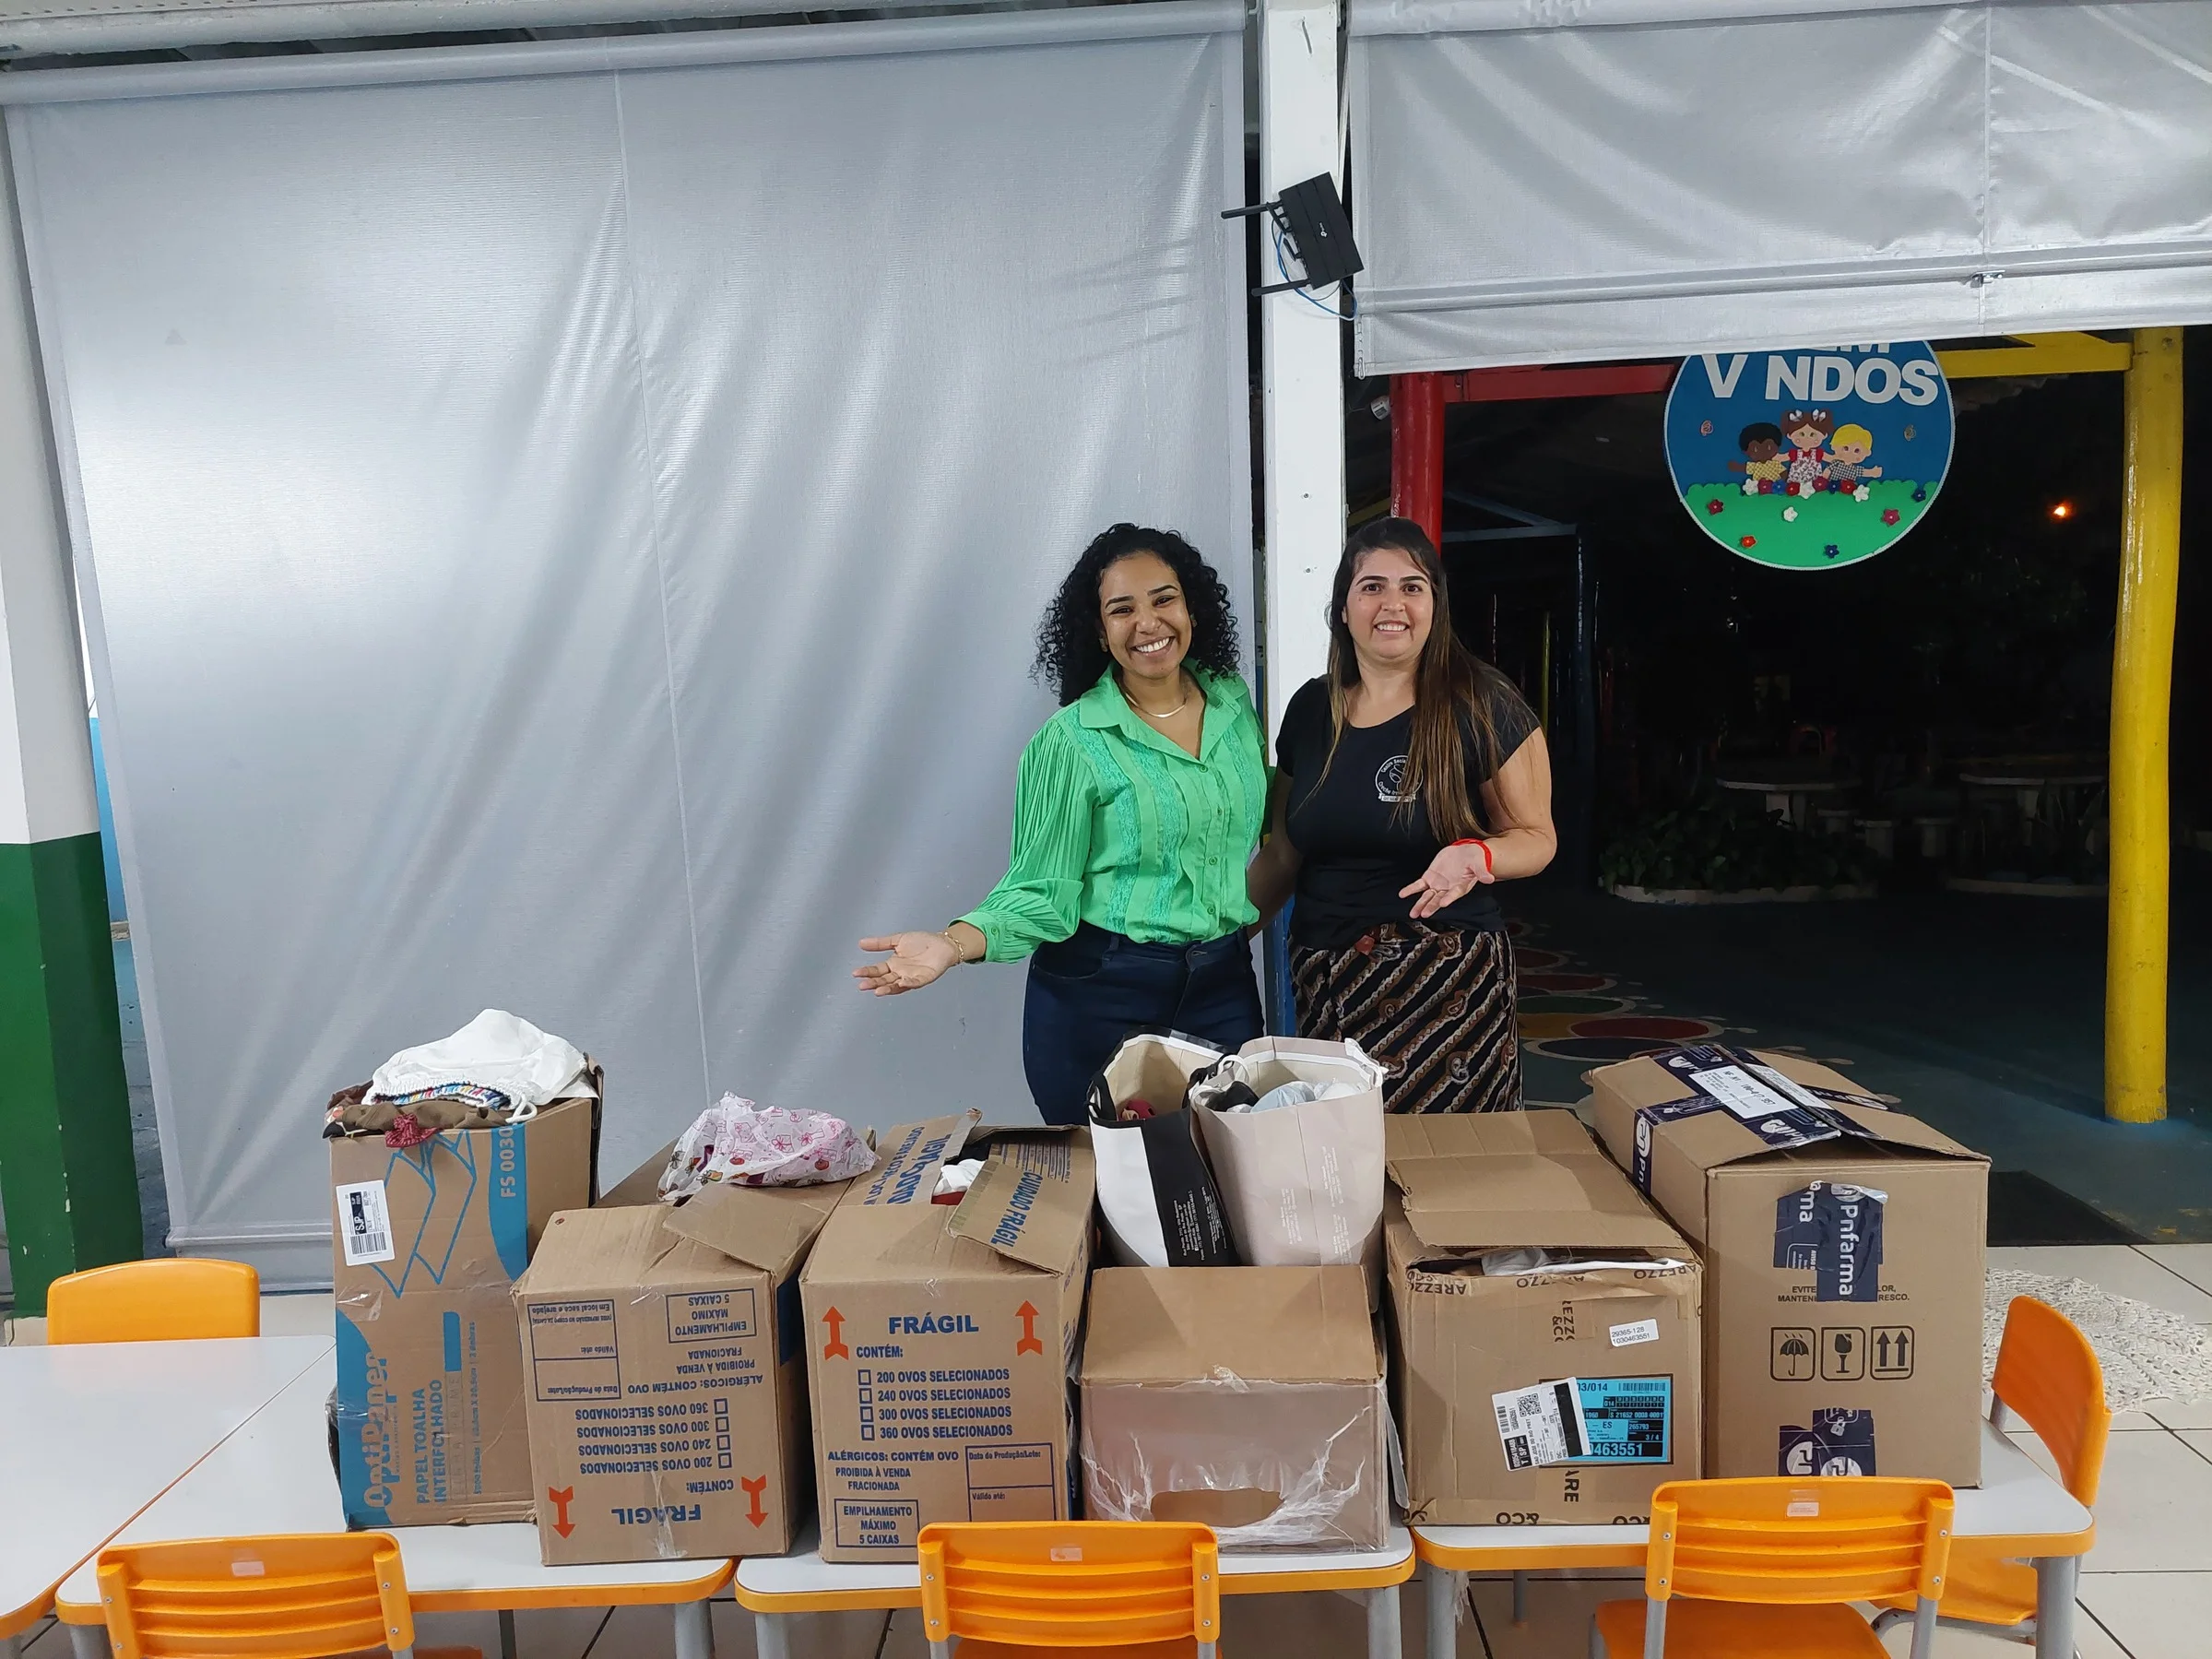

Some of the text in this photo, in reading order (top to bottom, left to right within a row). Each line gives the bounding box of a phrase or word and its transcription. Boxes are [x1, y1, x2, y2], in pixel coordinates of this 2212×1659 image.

[500, 1176, 516, 1198] FS
[1009, 1171, 1043, 1211] CUIDADO
[990, 1208, 1027, 1248] FRÁGIL
[1839, 1204, 1860, 1296] Pnfarma
[688, 1294, 730, 1307] 5 CAIXAS
[532, 1306, 557, 1315] arejado
[582, 1304, 598, 1312] local
[692, 1308, 728, 1321] MÁXIMO
[675, 1321, 747, 1336] EMPILHAMENTO
[888, 1311, 979, 1335] FRÁGIL
[594, 1345, 614, 1354] Válido
[688, 1346, 742, 1360] FRACIONADA
[856, 1344, 904, 1358] CONTÉM:
[676, 1363, 705, 1375] VENDA
[716, 1358, 755, 1370] PROIBIDA
[877, 1368, 1010, 1383] 200 OVOS SELECIONADOS
[603, 1385, 618, 1393] Data
[628, 1374, 763, 1394] ALÉRGICOS: CONTÉM OVO
[878, 1387, 1011, 1402] 240 OVOS SELECIONADOS
[575, 1402, 708, 1420] 360 OVOS SELECIONADOS
[879, 1405, 1011, 1420] 300 OVOS SELECIONADOS
[576, 1420, 710, 1439] 300 OVOS SELECIONADOS
[880, 1424, 1012, 1440] 360 OVOS SELECIONADOS
[1603, 1421, 1613, 1429] ES
[412, 1388, 431, 1504] PAPEL TOALHA
[430, 1380, 447, 1503] INTERFOLHADO
[578, 1438, 711, 1456] 240 OVOS SELECIONADOS
[828, 1449, 959, 1462] ALÉRGICOS: CONTÉM OVO
[968, 1452, 984, 1460] Data
[1519, 1447, 1527, 1456] SP
[580, 1456, 713, 1475] 200 OVOS SELECIONADOS
[835, 1464, 911, 1477] PROIBIDA À VENDA
[686, 1478, 734, 1493] CONTÉM:
[848, 1480, 900, 1491] FRACIONADA
[972, 1492, 991, 1500] Válido
[611, 1503, 702, 1527] FRÁGIL
[844, 1505, 912, 1517] EMPILHAMENTO
[860, 1518, 896, 1531] MÁXIMO
[859, 1534, 899, 1545] 5 CAIXAS
